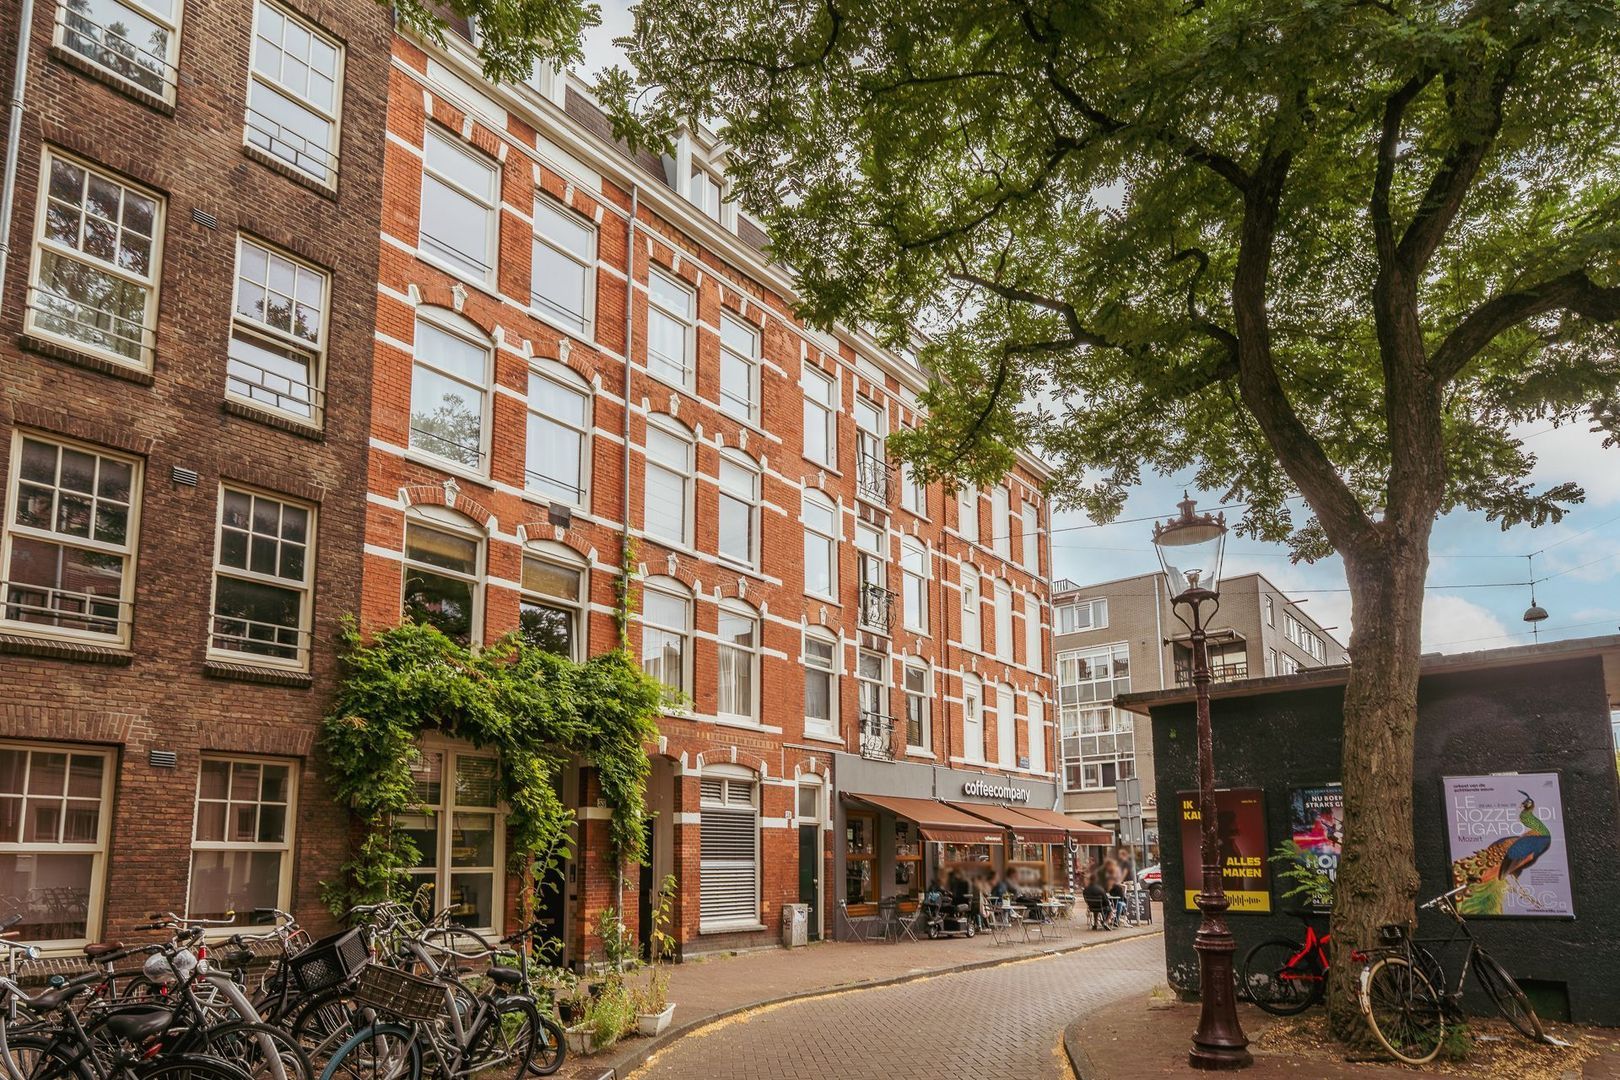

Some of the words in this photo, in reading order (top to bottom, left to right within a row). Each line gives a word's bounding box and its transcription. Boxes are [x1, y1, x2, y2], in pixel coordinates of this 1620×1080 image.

[964, 780, 1031, 803] coffeecompany
[1183, 800, 1194, 809] IK
[1454, 795, 1476, 809] LE
[1184, 811, 1201, 820] KA
[1455, 808, 1518, 822] NOZZE
[1538, 807, 1556, 820] DI
[1457, 822, 1526, 836] FIGARO
[1226, 857, 1262, 866] ALLES
[1222, 868, 1262, 878] MAKEN
